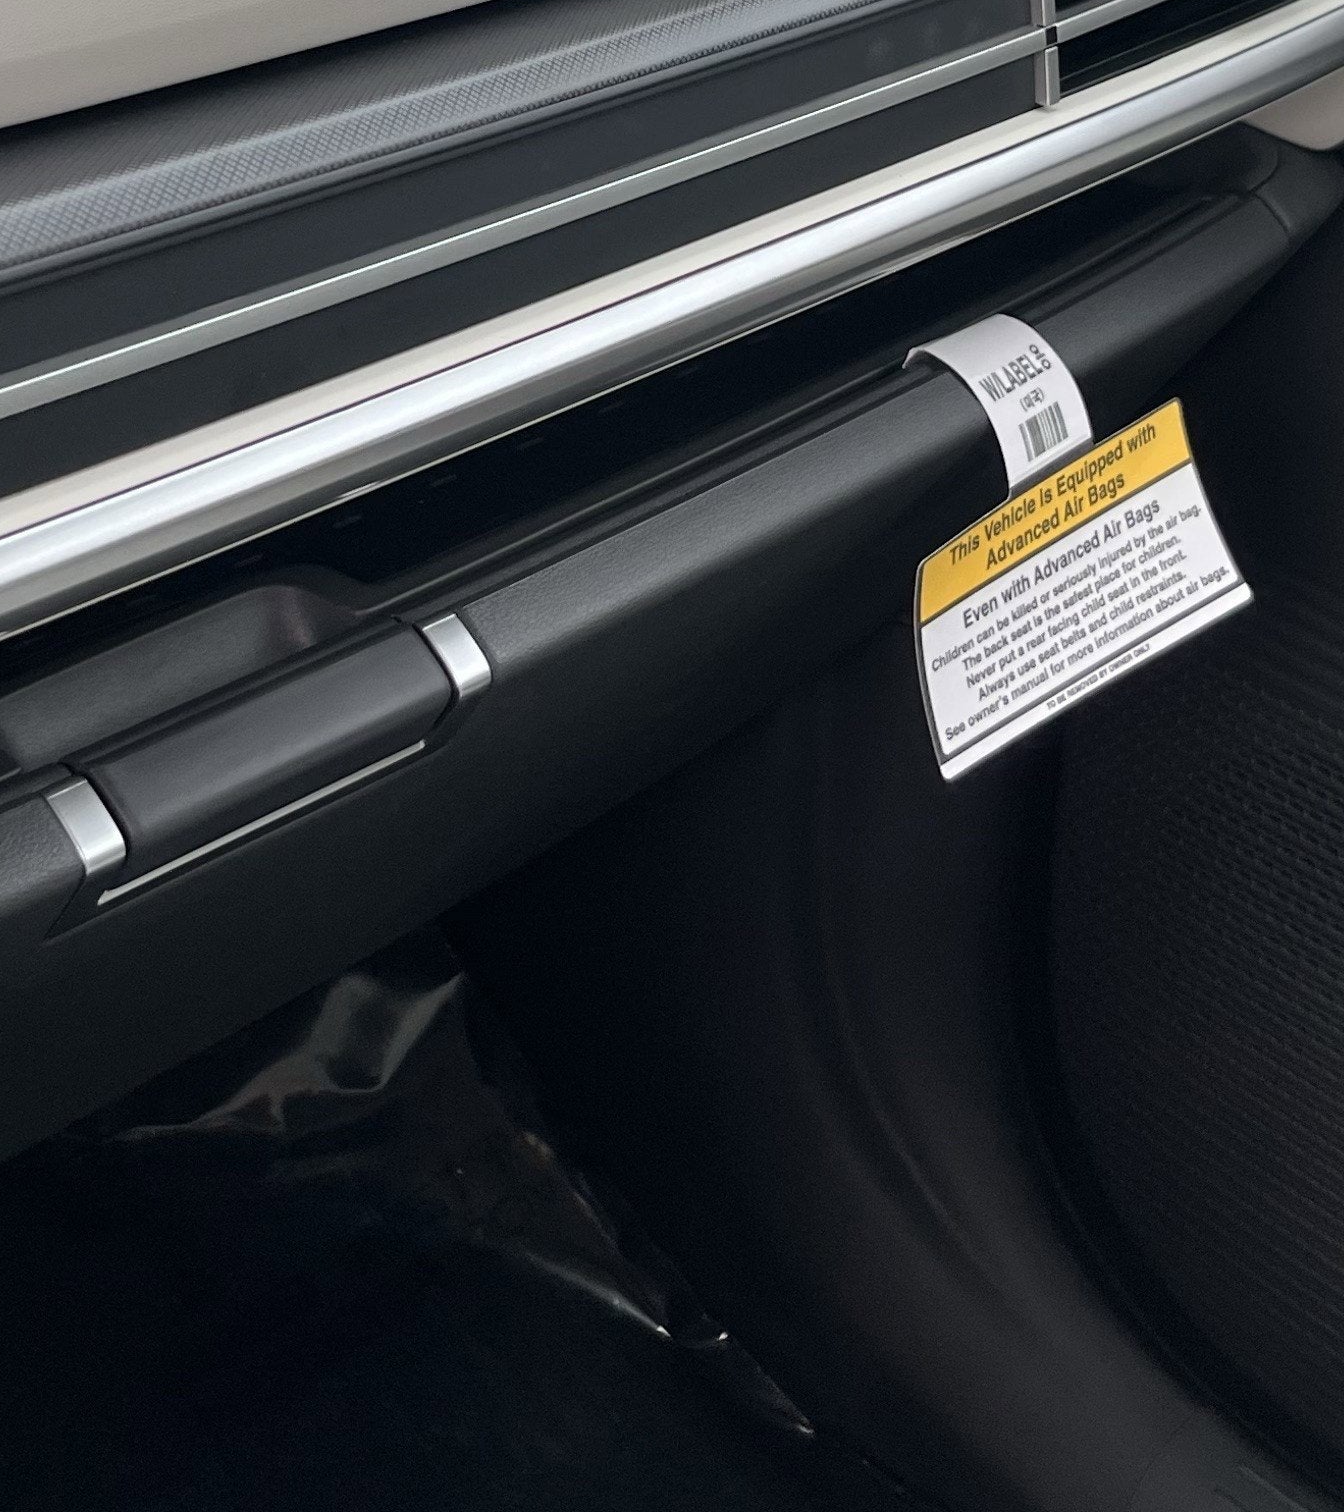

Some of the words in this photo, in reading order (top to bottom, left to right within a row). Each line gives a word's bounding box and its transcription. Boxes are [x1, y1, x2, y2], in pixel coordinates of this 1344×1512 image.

[949, 534, 980, 566] This
[984, 498, 1036, 541] Vehicle
[1039, 488, 1053, 507] is
[1056, 440, 1123, 496] Equipped
[1126, 423, 1156, 453] with
[986, 508, 1059, 570] Advanced
[1063, 495, 1084, 522] Air
[1087, 473, 1125, 506] Bags
[931, 638, 975, 672] Children
[976, 625, 995, 644] can
[996, 616, 1010, 631] be
[1011, 596, 1038, 622] killed
[1040, 590, 1051, 604] or
[1052, 563, 1097, 596] seriously
[1098, 540, 1133, 569] injured
[1133, 533, 1146, 548] by
[1147, 524, 1164, 540] the
[1165, 514, 1178, 530] air
[1178, 504, 1202, 522] bag.
[962, 596, 998, 629] Even
[1001, 574, 1031, 604] with
[1034, 529, 1100, 586] Advanced
[1103, 519, 1122, 544] Air
[1124, 499, 1160, 529] Bags
[962, 652, 983, 671] The
[983, 635, 1009, 659] back
[1010, 621, 1033, 642] seat
[1032, 614, 1044, 628] is
[1044, 604, 1061, 621] the
[1062, 583, 1094, 610] safest
[1094, 568, 1121, 594] place
[1121, 558, 1137, 575] for
[1138, 535, 1182, 565] children.
[966, 661, 996, 689] Never
[998, 649, 1017, 672] put
[1017, 646, 1025, 657] a
[1025, 630, 1046, 652] rear
[1047, 612, 1080, 638] facing
[1081, 593, 1106, 618] child
[1107, 581, 1130, 602] seat
[1129, 575, 1141, 589] in
[1141, 565, 1158, 582] the
[1158, 549, 1187, 571] front.
[945, 721, 966, 740] See
[967, 695, 1009, 727] owner's
[1011, 668, 1050, 700] manual
[1049, 658, 1065, 676] for
[1067, 643, 1094, 666] more
[1094, 608, 1154, 649] information
[1155, 588, 1186, 614] about
[1186, 580, 1199, 596] air
[1200, 565, 1230, 588] bags.
[978, 671, 1016, 702] Always
[1017, 659, 1037, 676] use
[1038, 642, 1061, 664] seat
[1060, 628, 1087, 649] belts
[1088, 611, 1108, 633] and
[1109, 596, 1135, 620] child
[1135, 571, 1187, 605] restraints.
